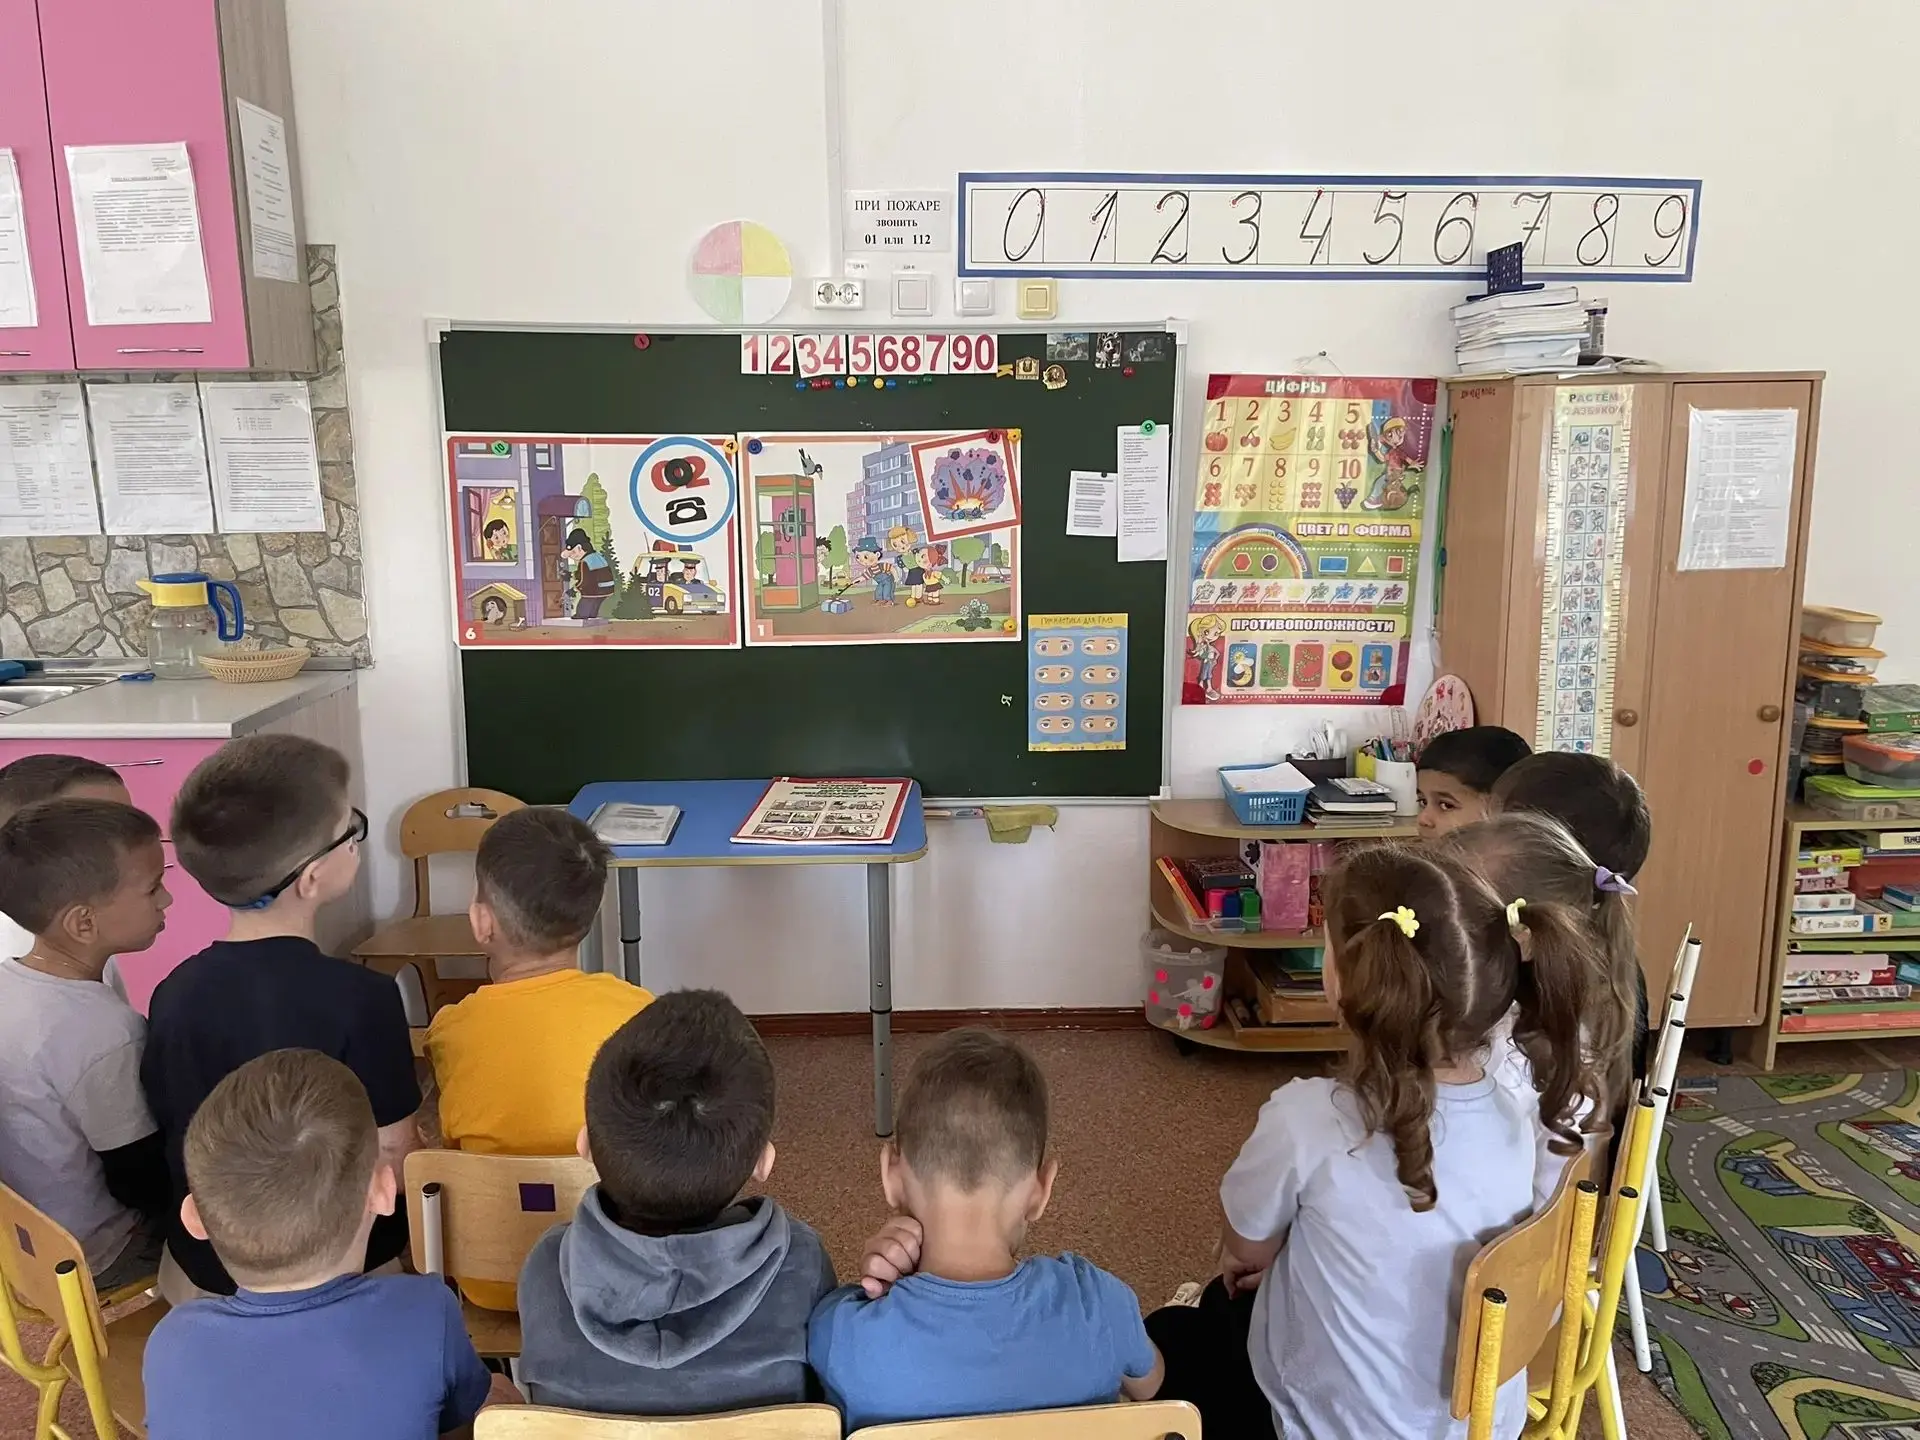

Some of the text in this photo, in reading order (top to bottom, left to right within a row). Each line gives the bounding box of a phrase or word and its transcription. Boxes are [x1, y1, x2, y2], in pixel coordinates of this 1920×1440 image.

[855, 200, 941, 211] ПРИ ПОЖАРЕ
[876, 219, 918, 227] звонить
[1004, 188, 1687, 267] 0 1 2 3 4 5 6 7 8 9
[864, 234, 931, 245] 01 или 112
[1265, 379, 1327, 394] ЦИФРЫ
[1216, 399, 1360, 424] 1 2 3 4 5
[1209, 457, 1362, 479] 6 7 8 9 10
[1297, 523, 1411, 537] ЦВЕТ И ФОРМА
[648, 587, 660, 597] 02
[757, 624, 764, 637] 1
[1231, 619, 1395, 632] ПРОТИВОПОЛОЖНОСТИ
[465, 627, 476, 640] 6
